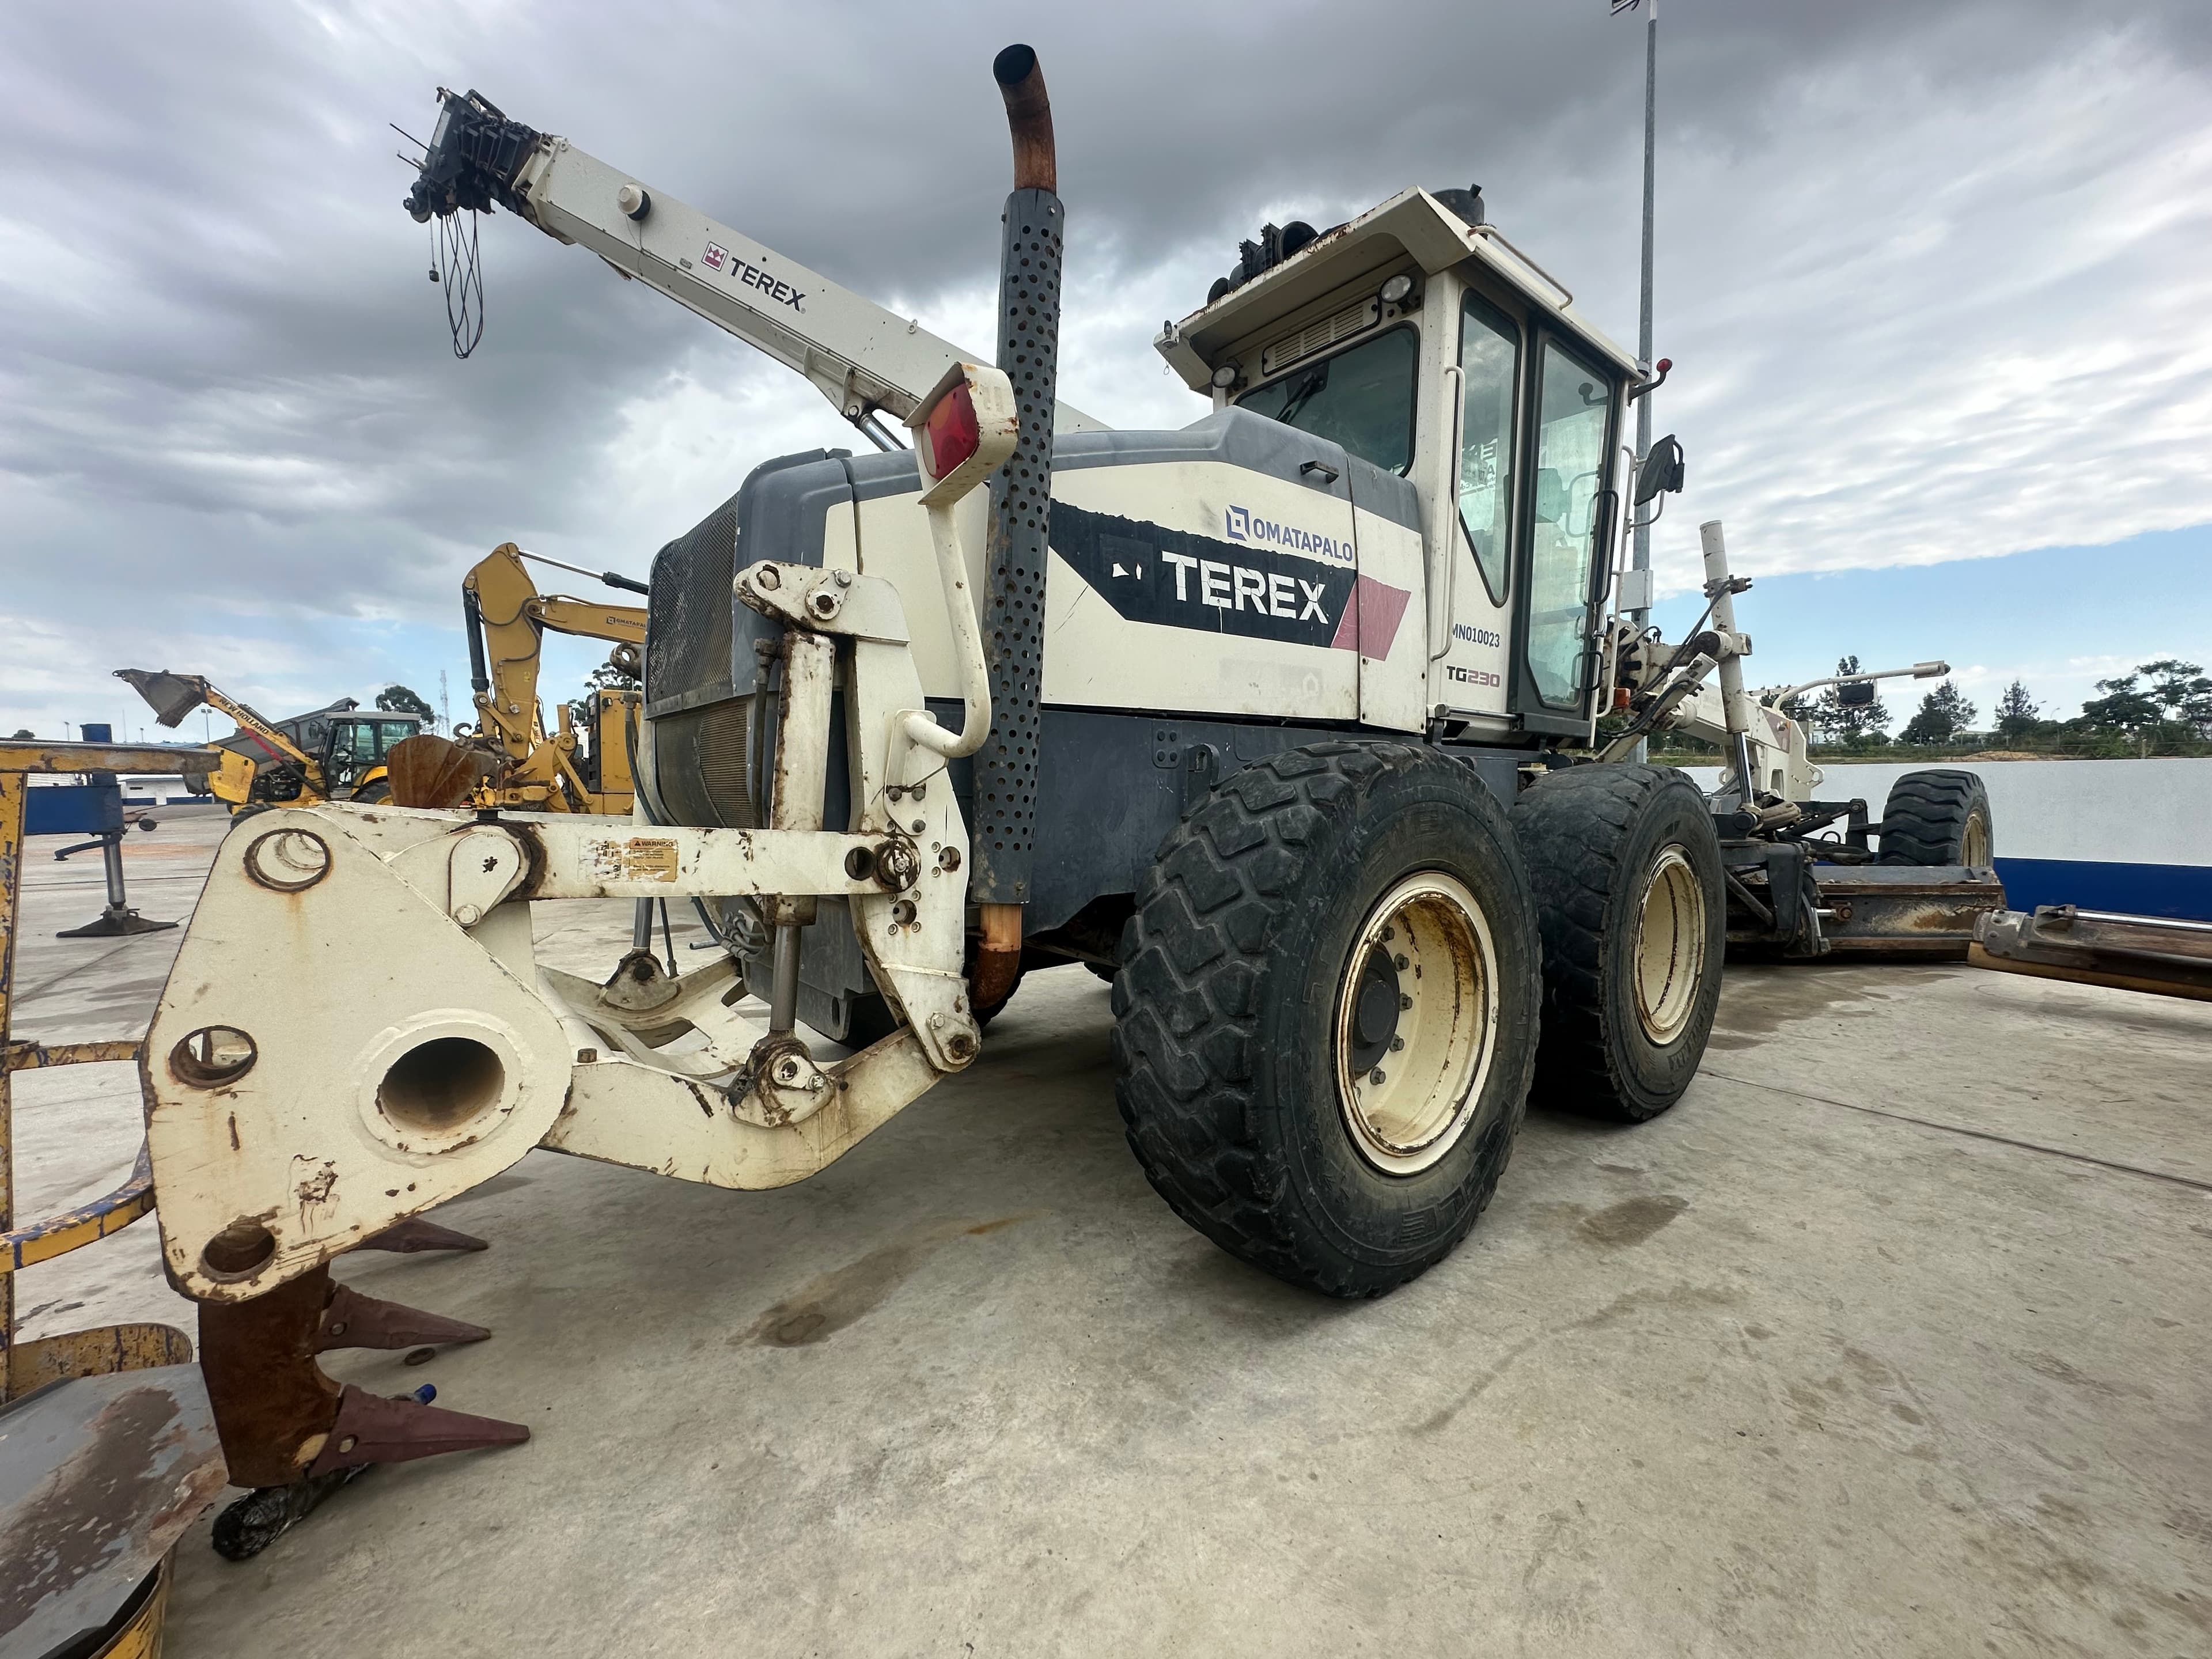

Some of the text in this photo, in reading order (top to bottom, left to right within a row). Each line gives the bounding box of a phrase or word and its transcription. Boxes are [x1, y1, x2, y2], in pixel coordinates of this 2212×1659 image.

[730, 257, 806, 312] TEREX
[1253, 518, 1353, 562] OMATAPALO
[1162, 551, 1329, 624] TEREX
[616, 619, 646, 627] OMATAPAL
[1446, 665, 1500, 687] TG230
[219, 698, 268, 734] NEW HOLLAND
